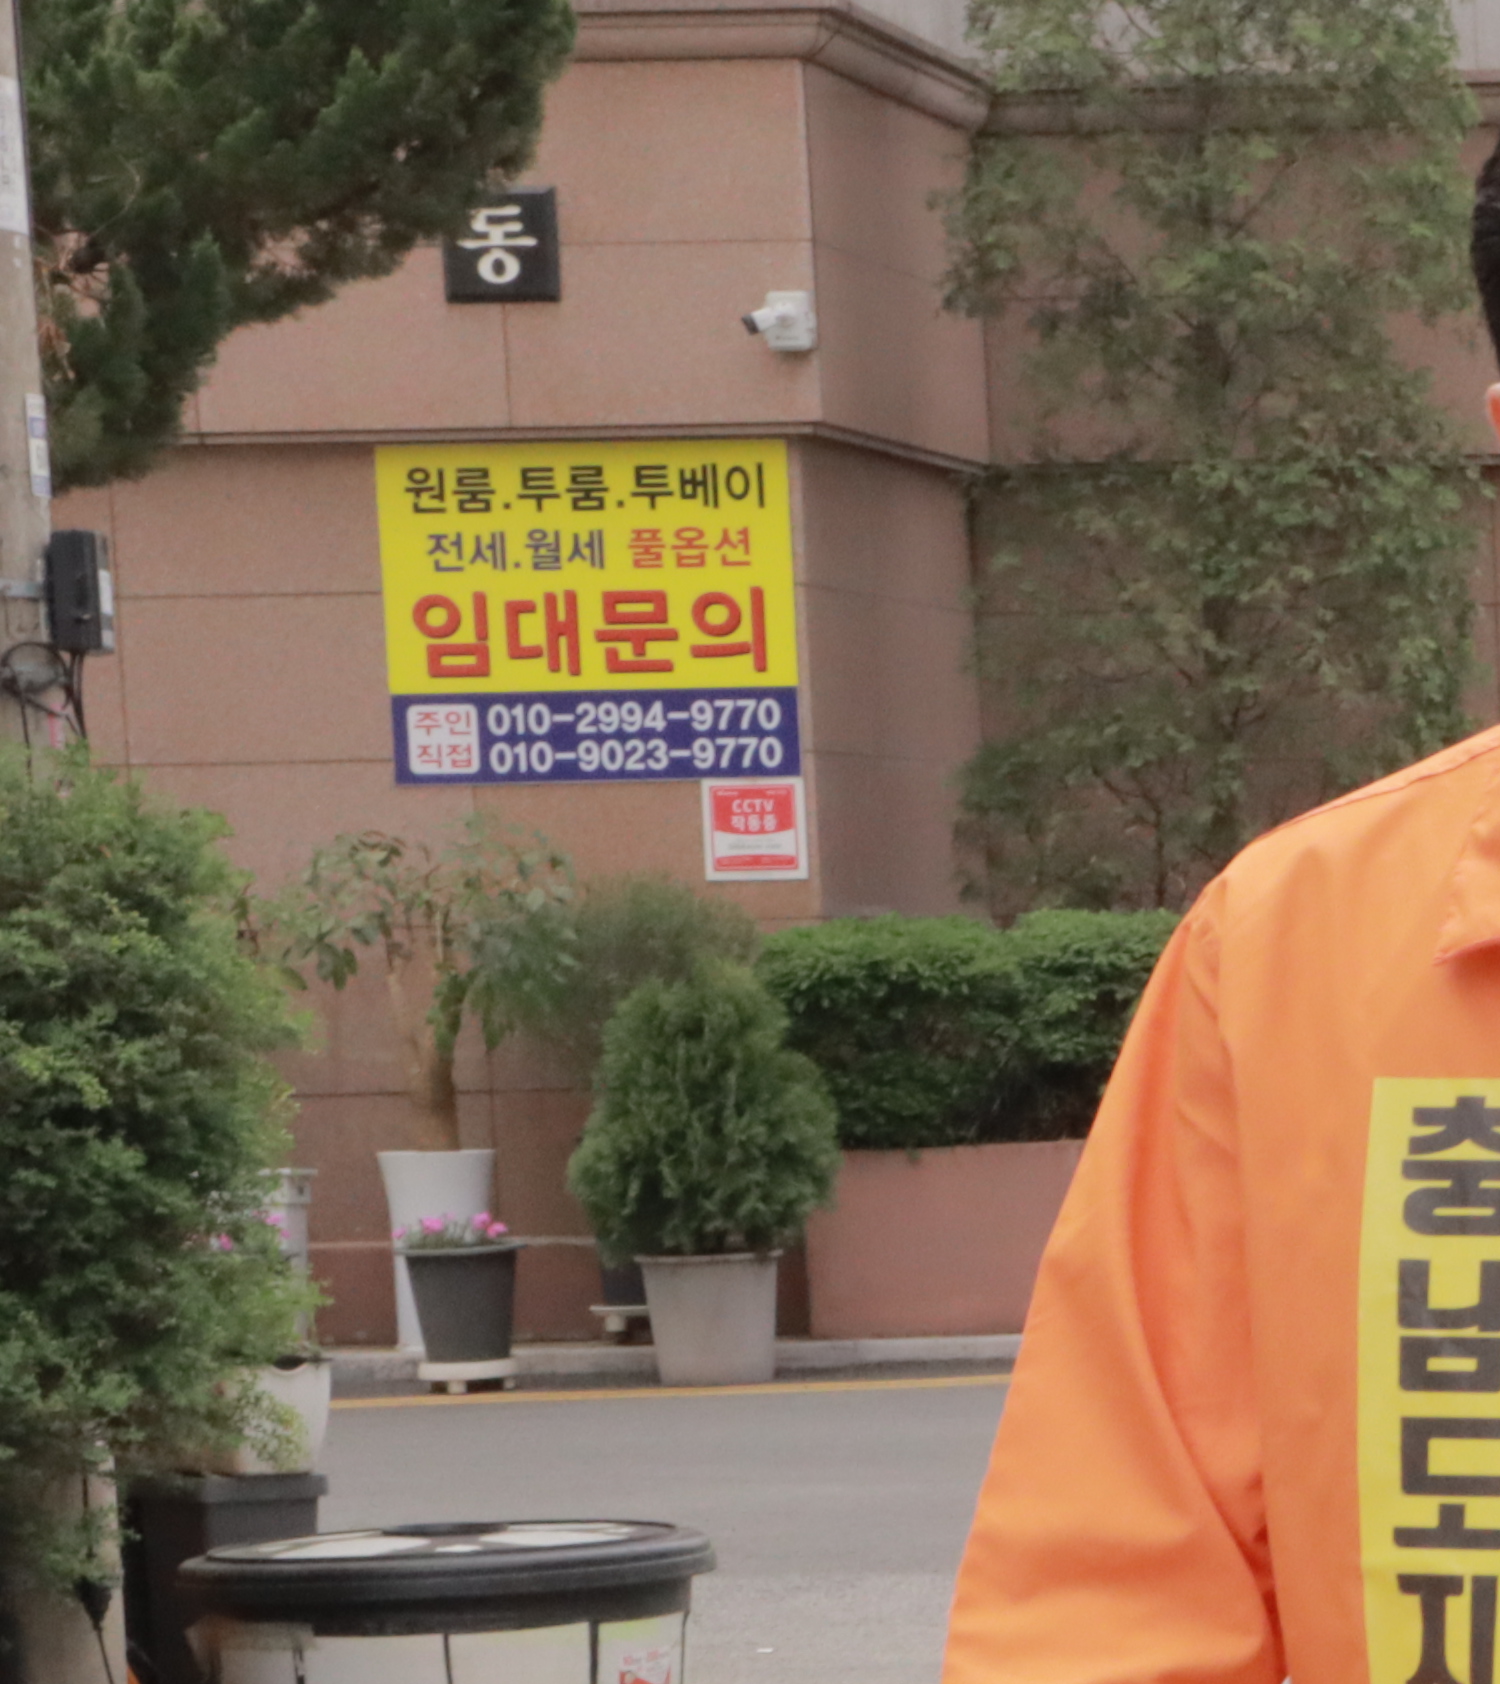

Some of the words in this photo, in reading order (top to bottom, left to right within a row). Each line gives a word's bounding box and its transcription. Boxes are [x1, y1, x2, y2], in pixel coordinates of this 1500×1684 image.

[456, 204, 538, 284] 동
[404, 462, 767, 515] 원룸.투룸.투베이
[427, 528, 606, 573] 전세.월세
[628, 526, 753, 569] 풀옵션
[411, 585, 768, 678] 임대문의
[414, 711, 472, 737] 주인
[487, 698, 781, 736] 010-2994-9770
[415, 745, 473, 769] 직접
[489, 737, 783, 775] 010-9023-9770
[731, 798, 775, 813] CCTV
